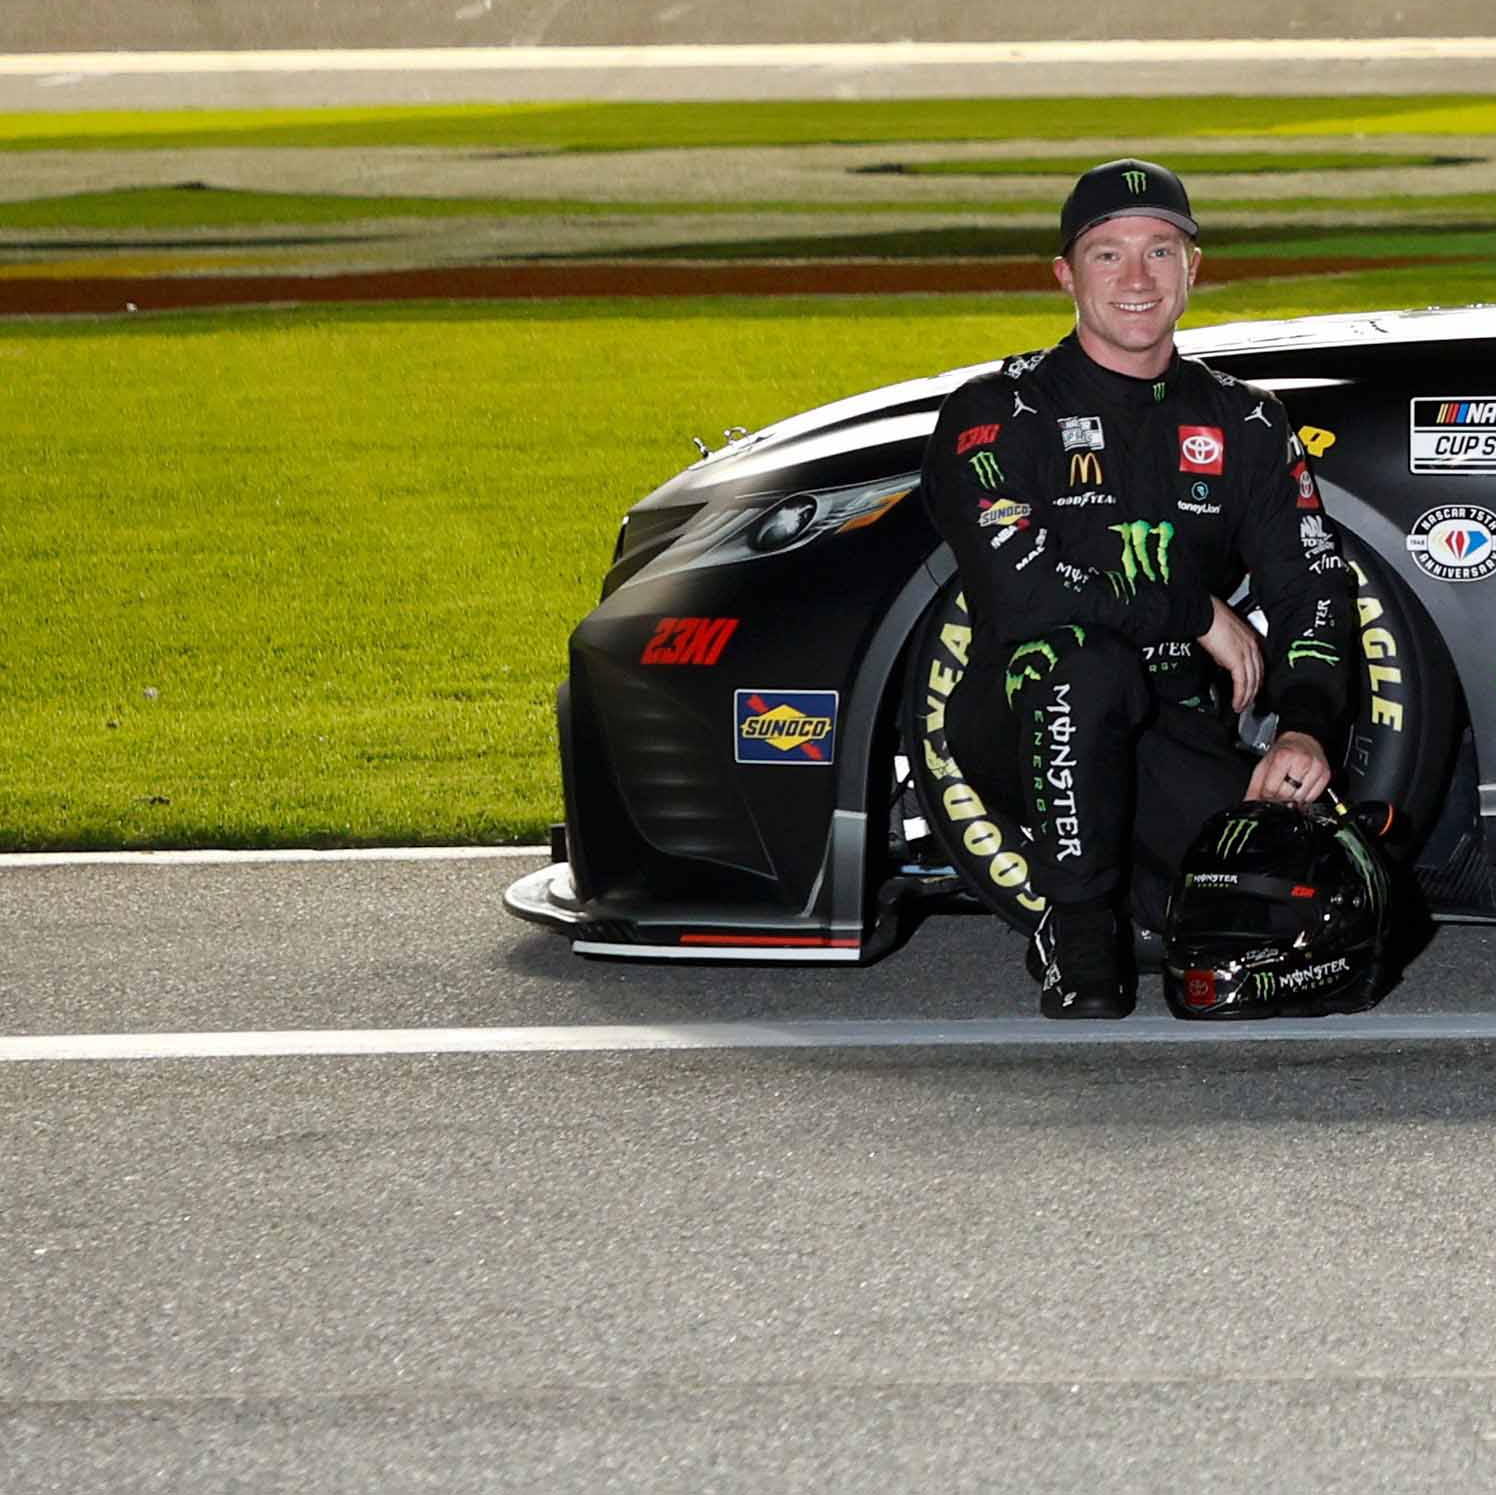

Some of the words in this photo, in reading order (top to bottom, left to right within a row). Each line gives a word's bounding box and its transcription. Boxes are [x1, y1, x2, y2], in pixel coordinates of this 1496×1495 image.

[1435, 436, 1480, 456] CUP
[982, 505, 1029, 524] SUNOCO
[1420, 508, 1467, 532] NASCAR
[639, 616, 741, 666] 23XI
[744, 718, 828, 738] SUNOCO
[1045, 683, 1083, 862] MONSTER
[1193, 873, 1239, 885] MONSTER
[1279, 957, 1351, 989] MONSTER
